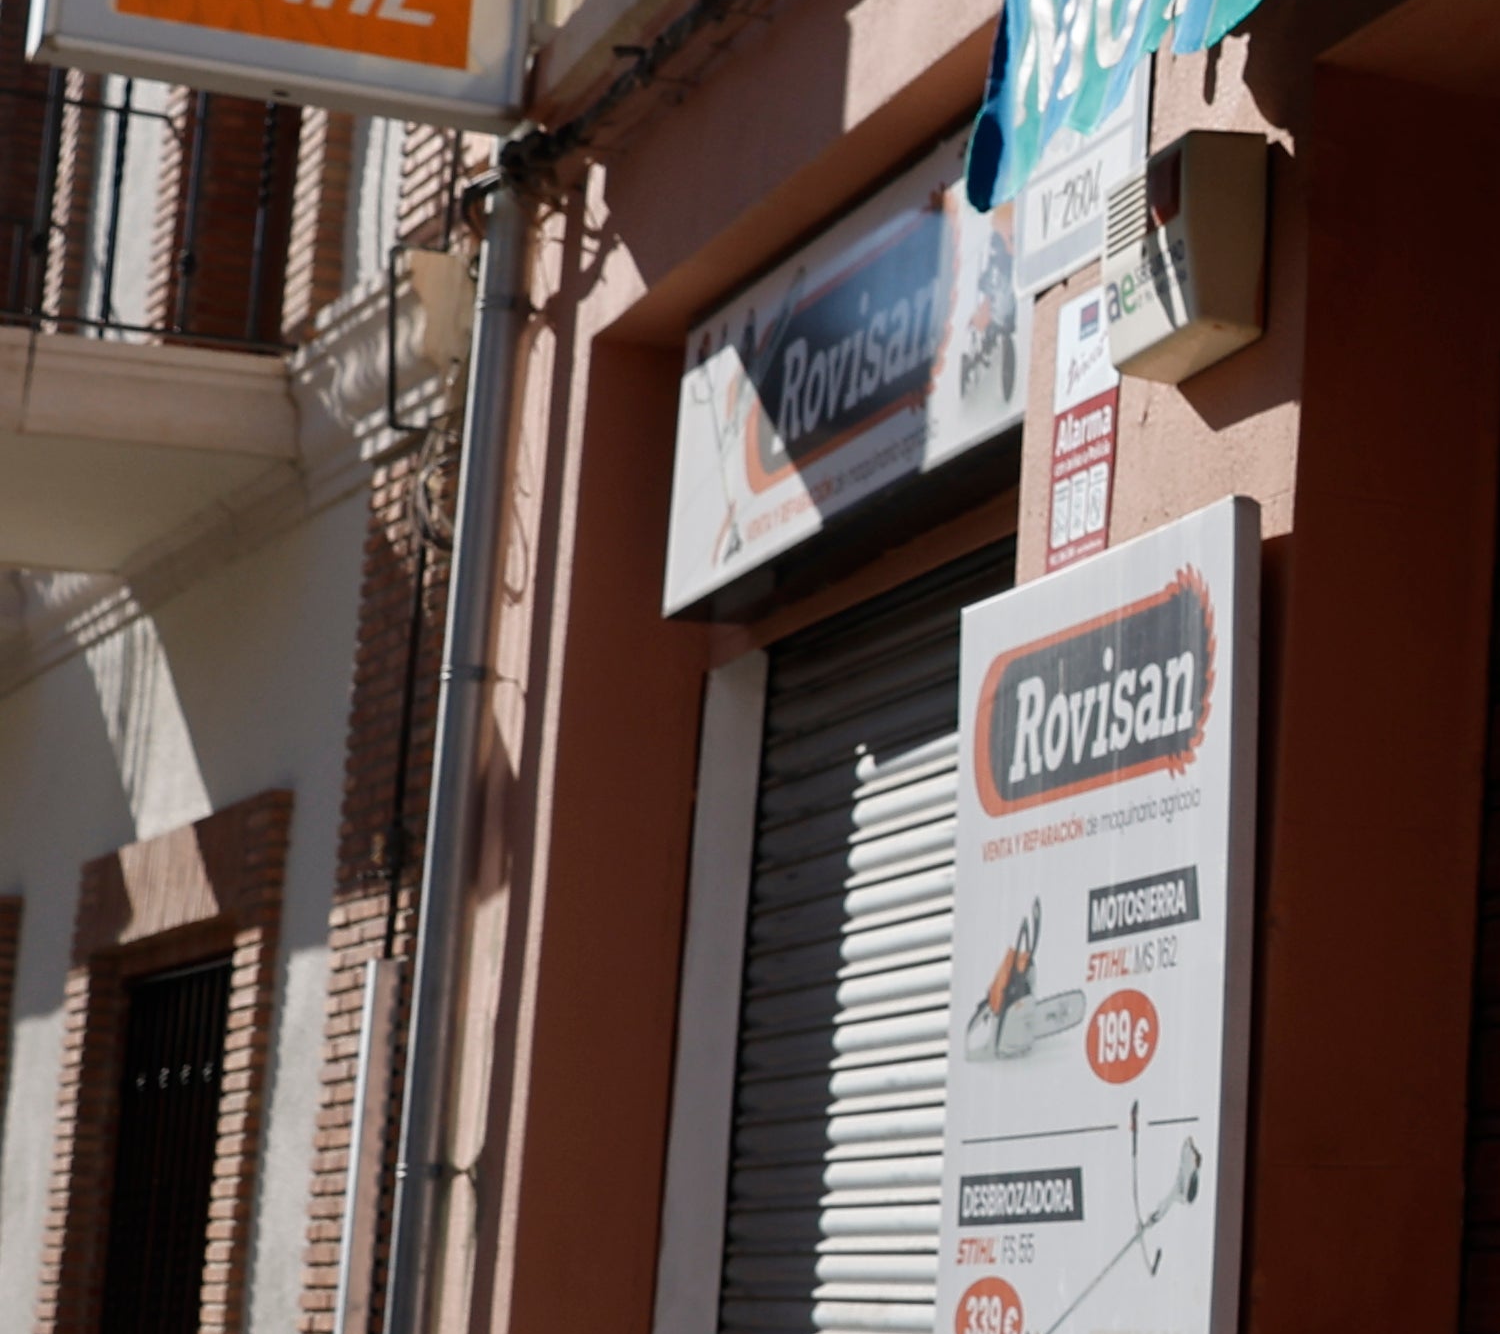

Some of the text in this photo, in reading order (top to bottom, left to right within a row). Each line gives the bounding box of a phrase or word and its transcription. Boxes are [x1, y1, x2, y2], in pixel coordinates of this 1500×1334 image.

[768, 275, 940, 457] Rovisan
[1009, 647, 1195, 784] Rovisan
[1090, 878, 1187, 934] MOTOSIERRA
[1086, 946, 1132, 983] STIHL
[1096, 1008, 1150, 1064] 199 €
[961, 1178, 1075, 1219] DESBROZADORA
[956, 1236, 998, 1266] STIHL
